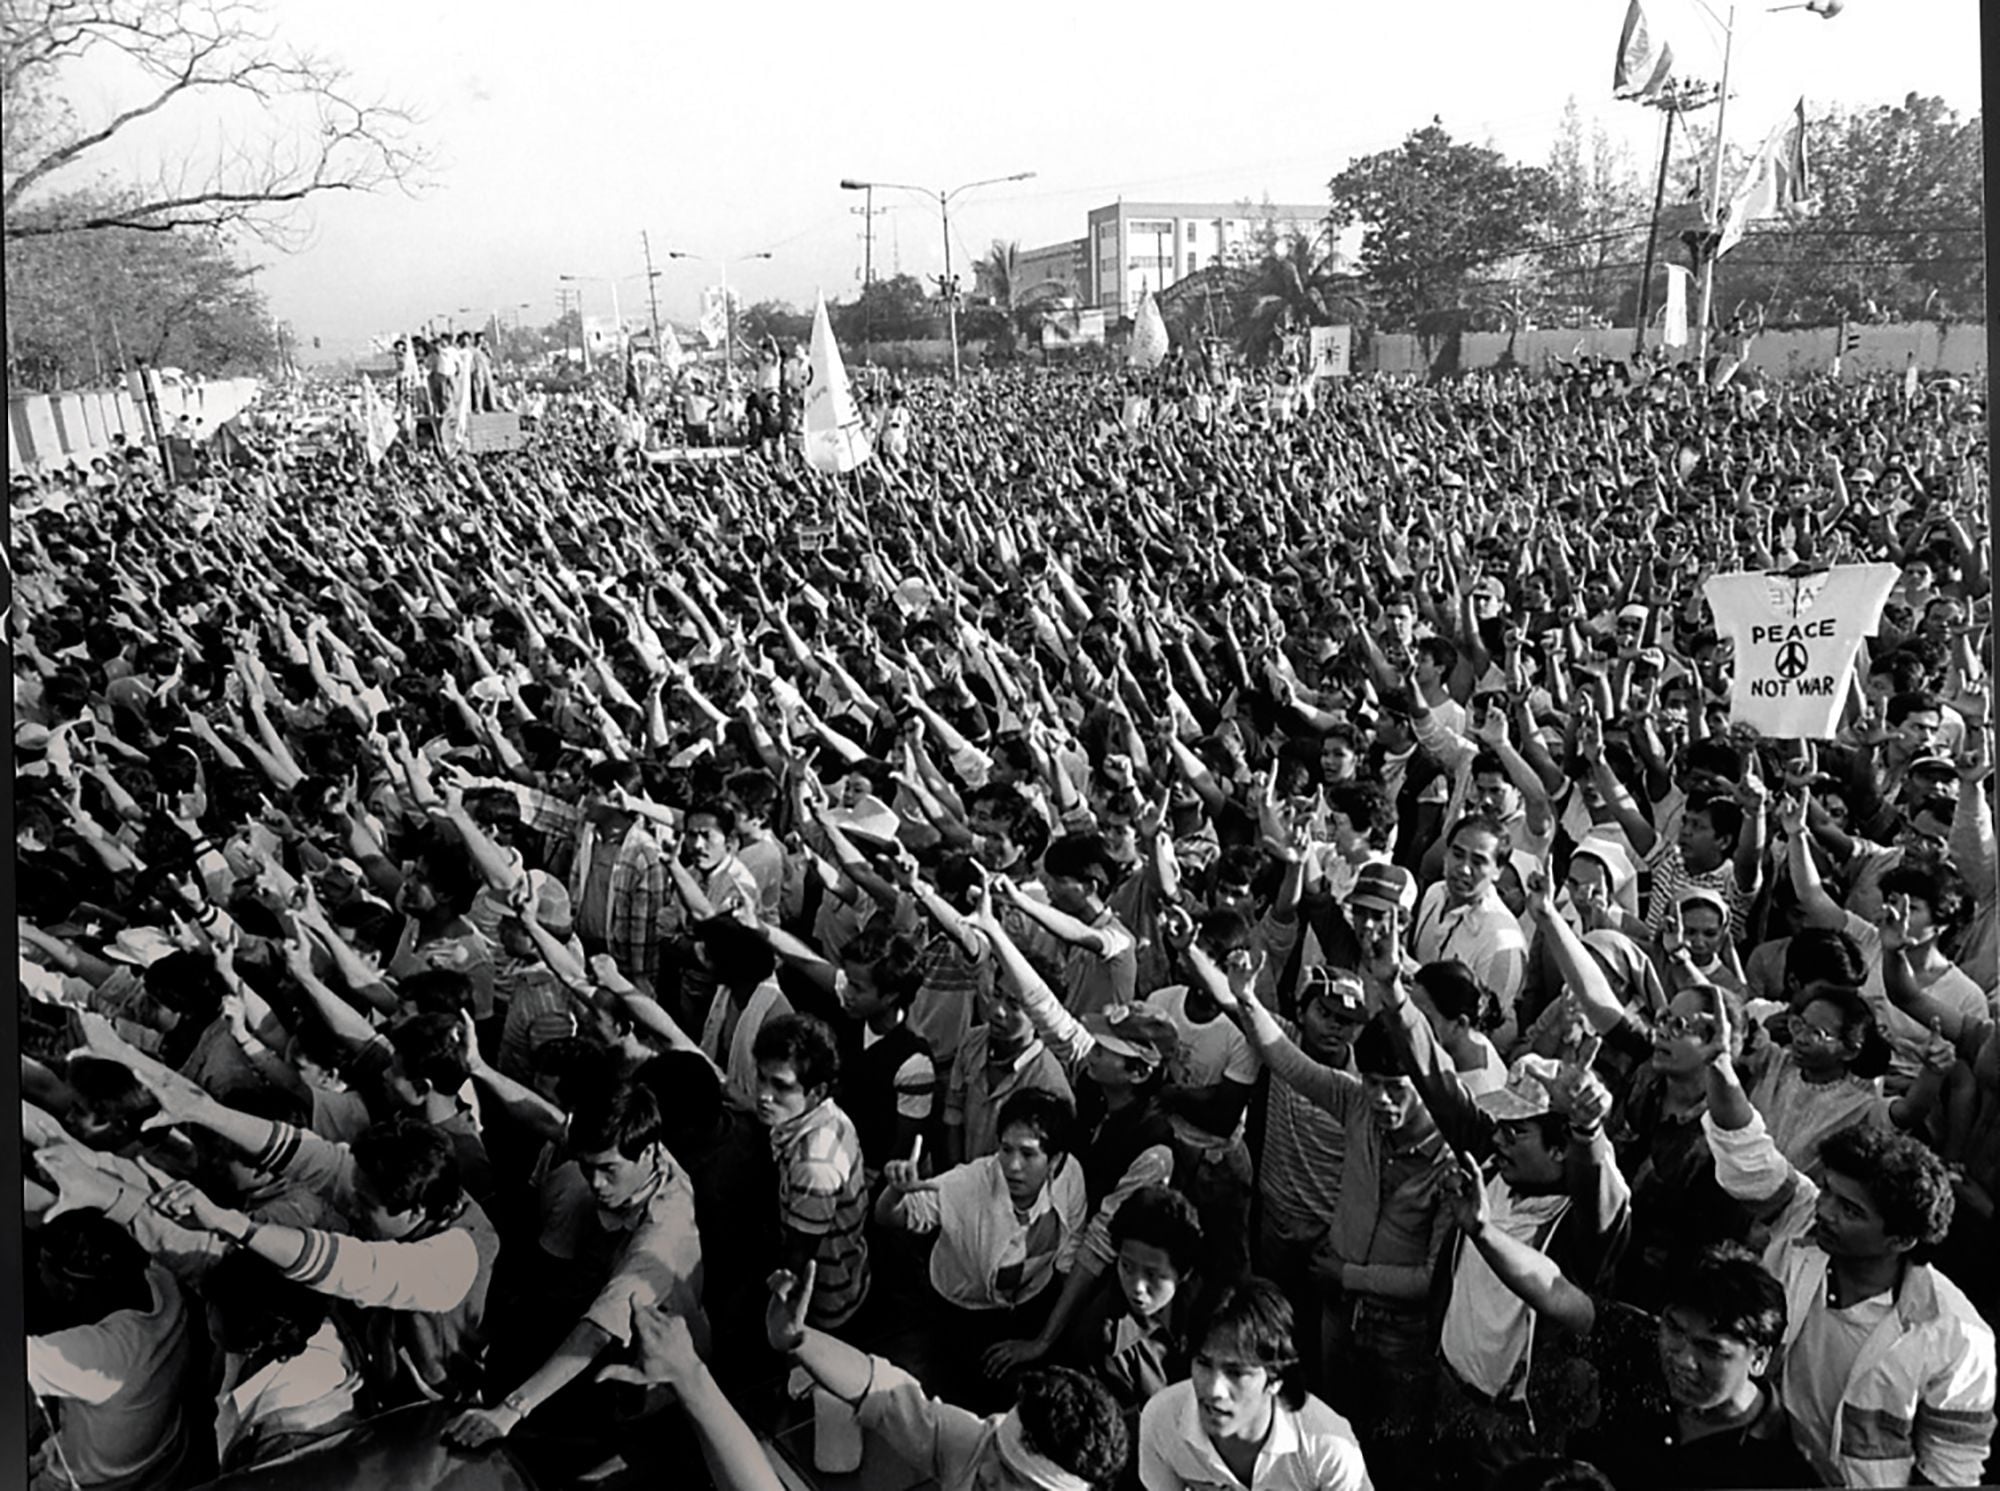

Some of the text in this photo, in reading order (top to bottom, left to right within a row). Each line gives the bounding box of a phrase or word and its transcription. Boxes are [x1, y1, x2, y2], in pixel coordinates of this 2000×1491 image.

[1751, 618, 1837, 645] PEACE
[1751, 675, 1834, 698] NOT WAR
